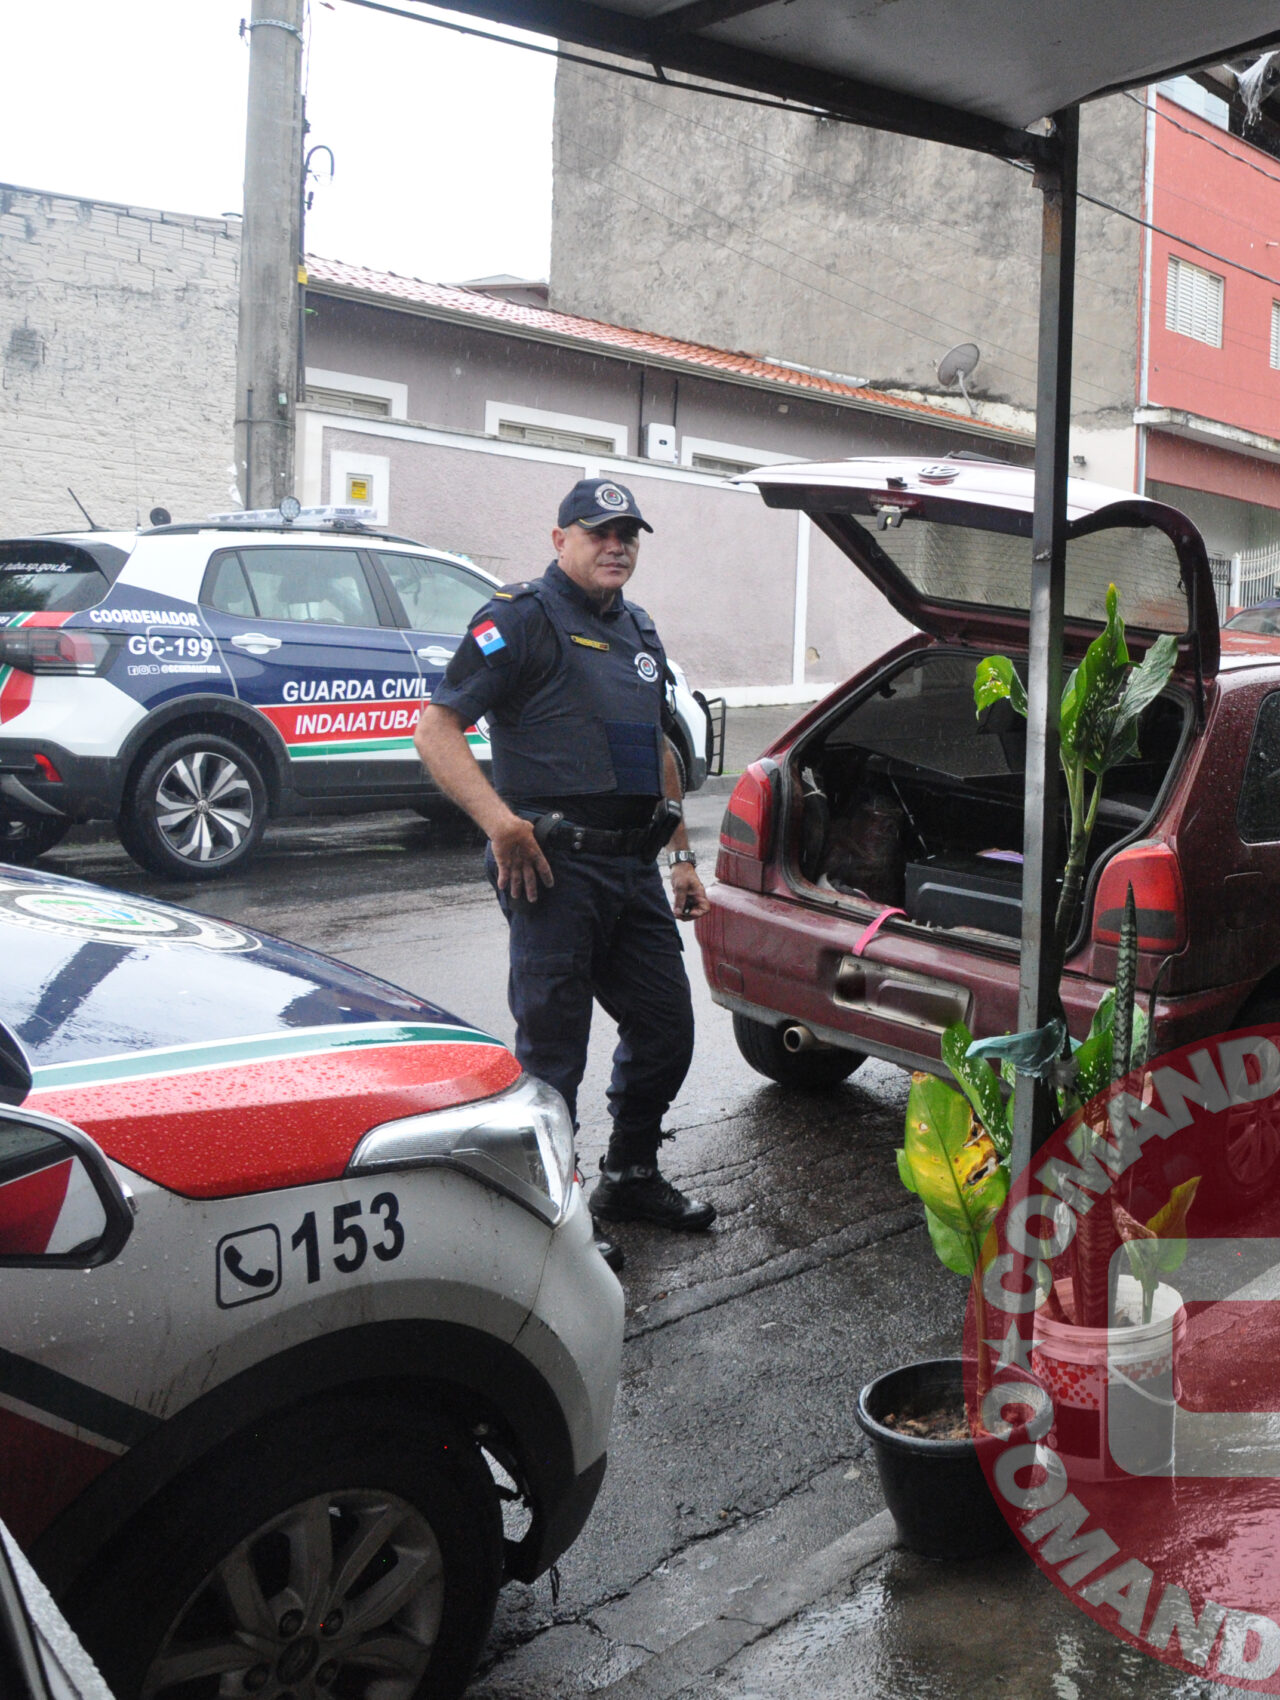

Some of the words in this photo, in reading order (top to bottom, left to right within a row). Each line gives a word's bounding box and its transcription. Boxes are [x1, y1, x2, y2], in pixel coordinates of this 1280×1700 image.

[89, 609, 200, 627] COORDENADOR
[128, 635, 213, 657] GC-199
[282, 679, 376, 702] GUARDA
[382, 678, 432, 698] CIVIL
[295, 709, 421, 735] INDAIATUBA
[291, 1191, 405, 1284] 153
